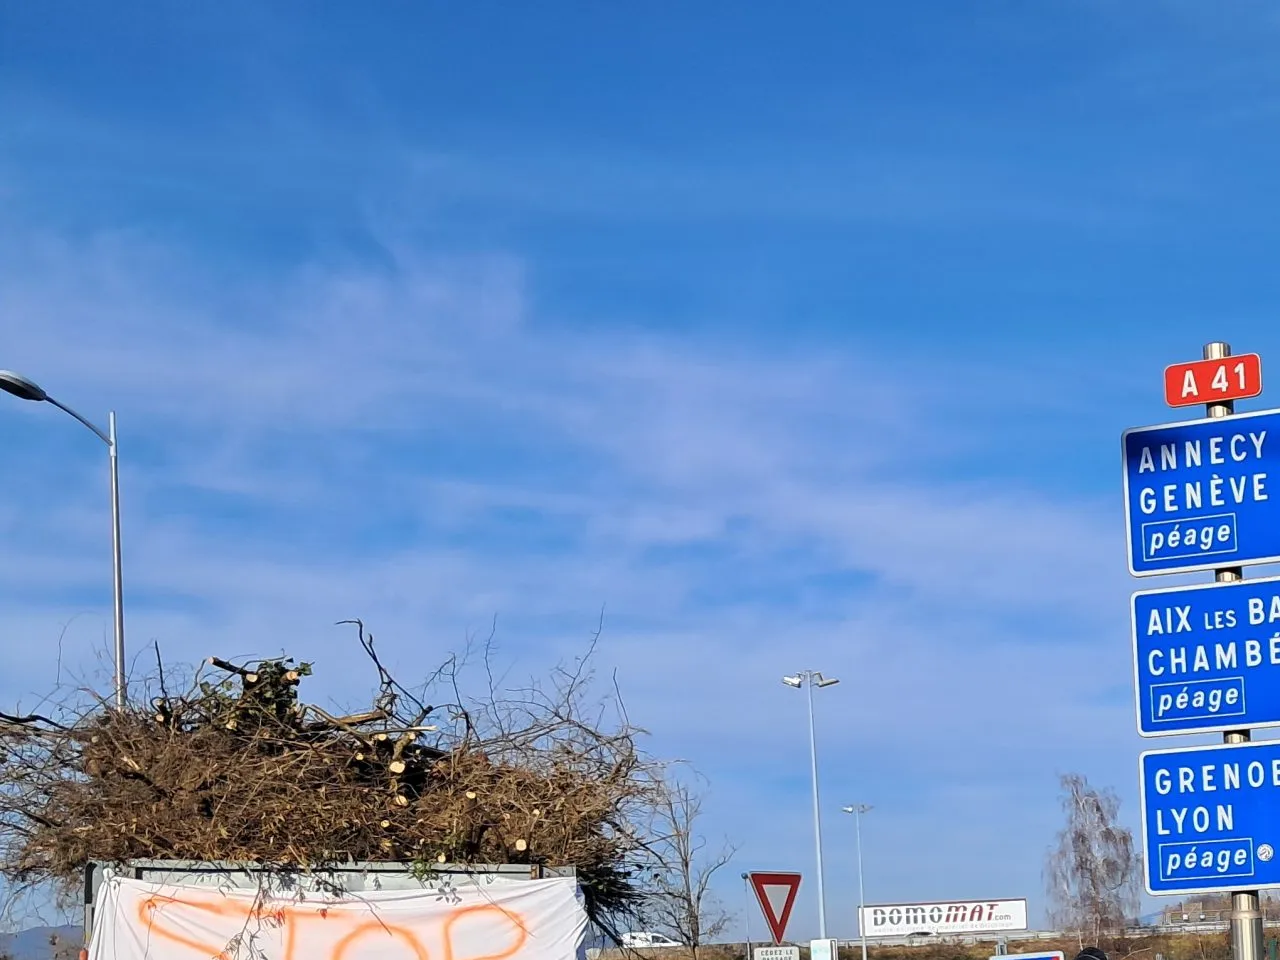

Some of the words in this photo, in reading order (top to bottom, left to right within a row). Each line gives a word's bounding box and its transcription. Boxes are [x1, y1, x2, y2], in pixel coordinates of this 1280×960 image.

[1181, 370, 1199, 398] A
[1211, 362, 1247, 393] 41
[1138, 431, 1267, 474] ANNECY
[1139, 472, 1269, 515] GENÈVE
[1150, 521, 1231, 556] péage
[1147, 605, 1192, 636] AIX
[1204, 609, 1237, 630] LES
[1158, 686, 1239, 716] péage
[1156, 804, 1235, 836] LYON
[1166, 847, 1248, 876] péage
